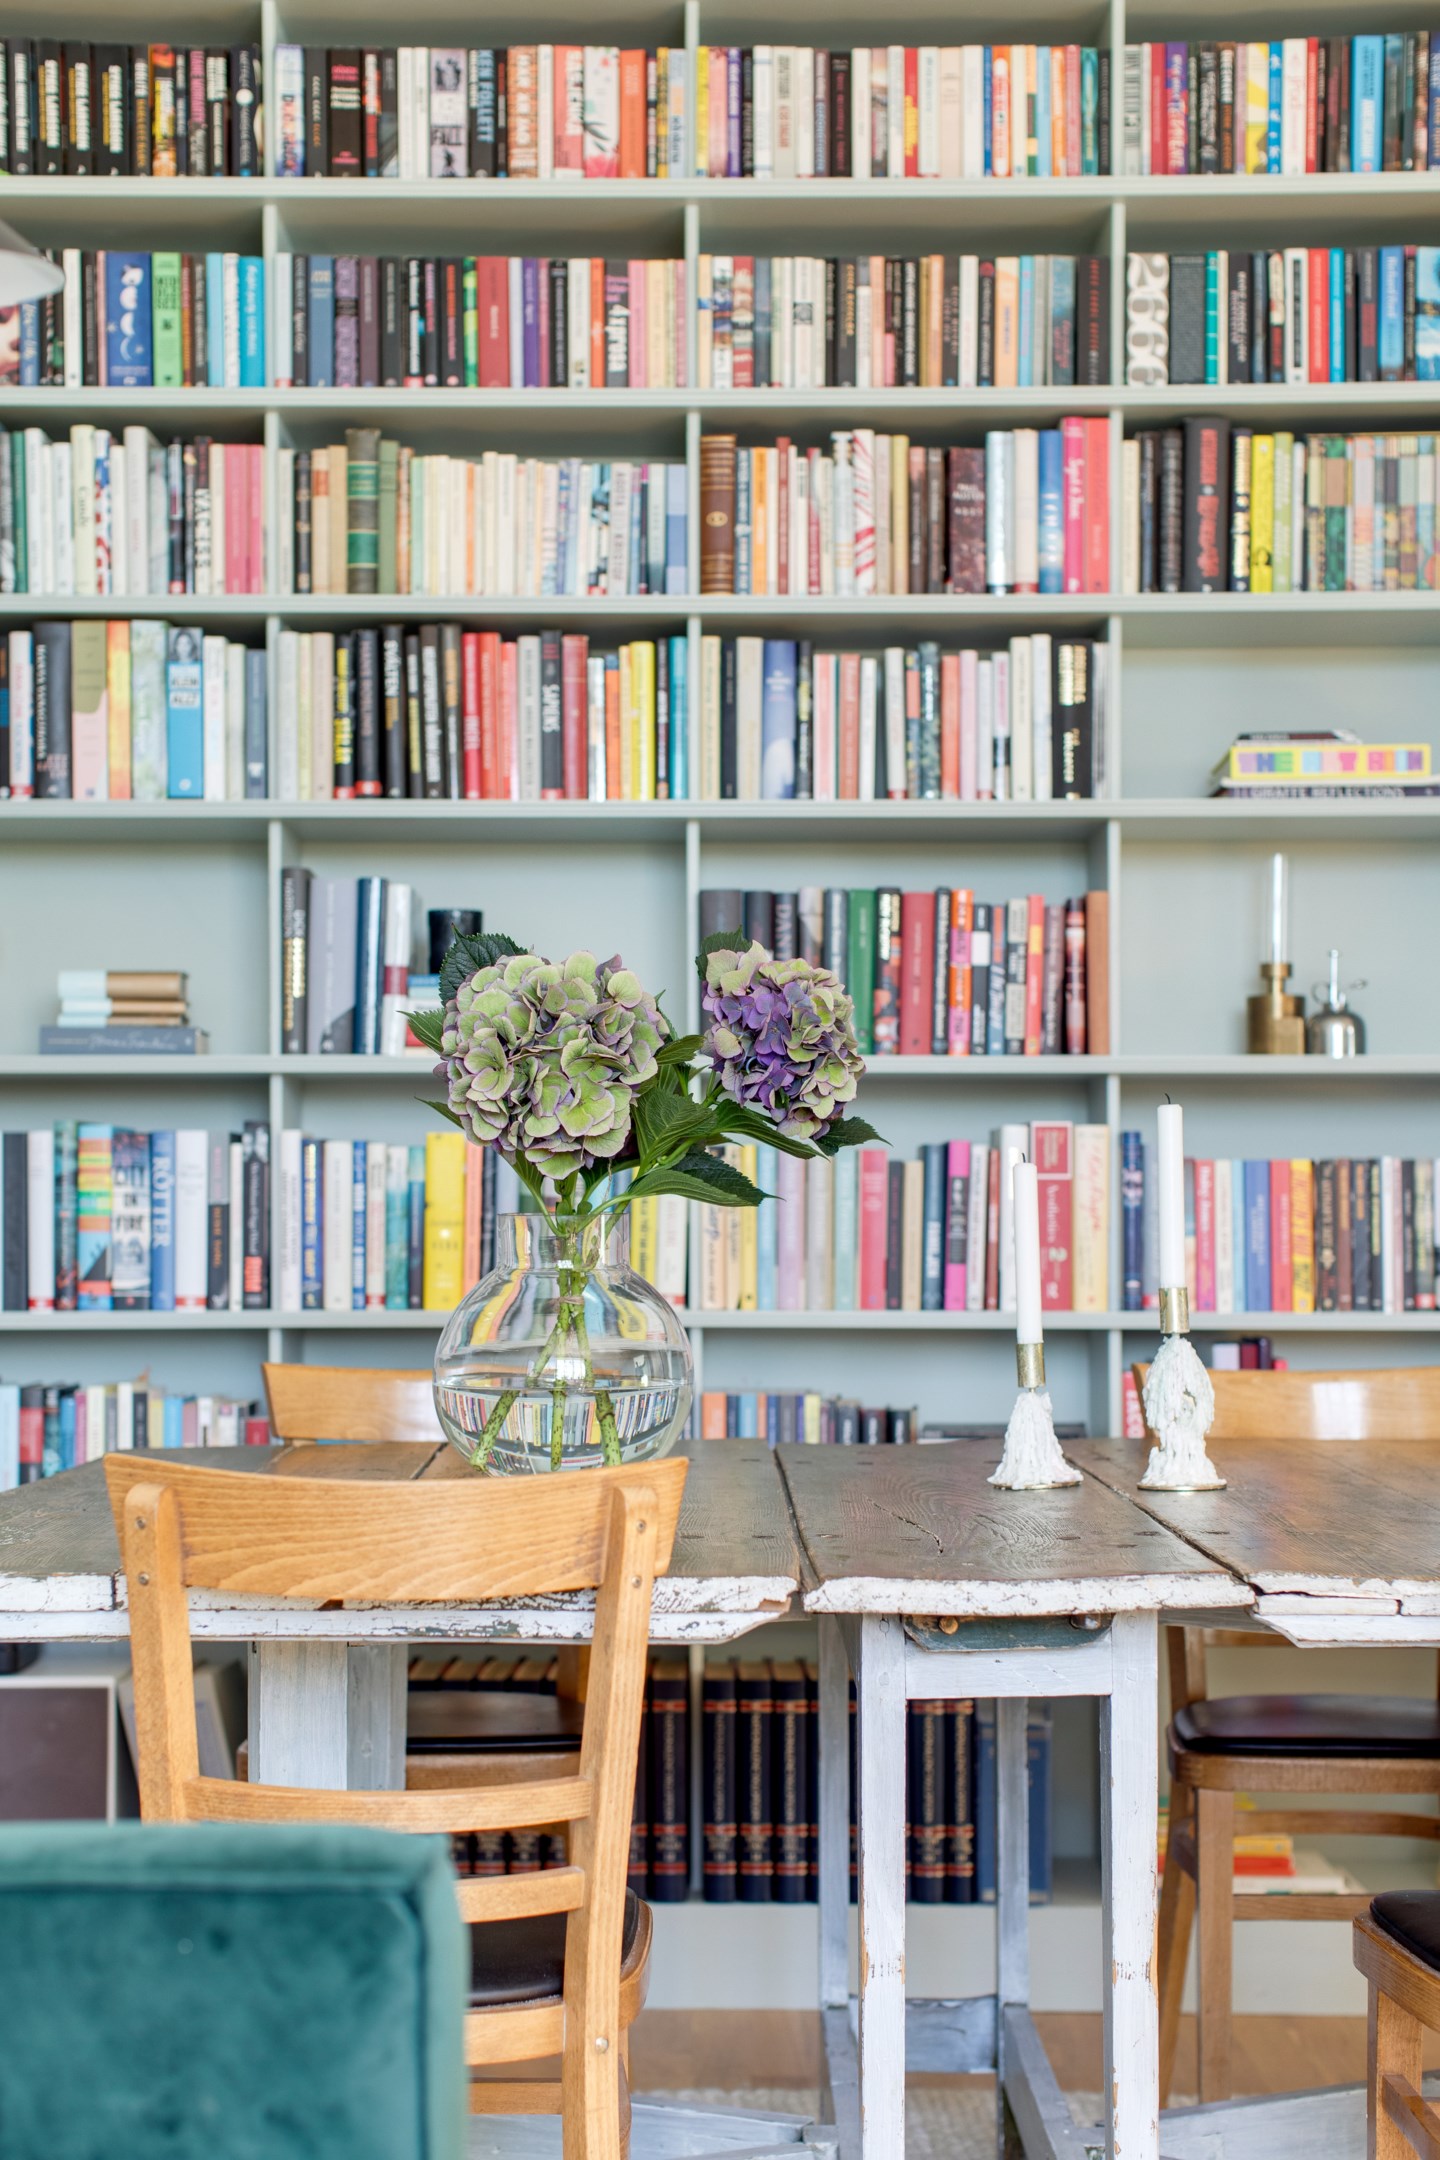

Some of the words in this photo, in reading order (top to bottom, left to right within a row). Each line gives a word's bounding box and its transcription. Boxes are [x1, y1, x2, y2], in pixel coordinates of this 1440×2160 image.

[477, 49, 495, 81] KEN
[476, 81, 495, 144] FOLLETT
[1126, 252, 1171, 386] 2666
[542, 683, 561, 734] SAPIENS
[152, 1155, 175, 1248] RÖTTER
